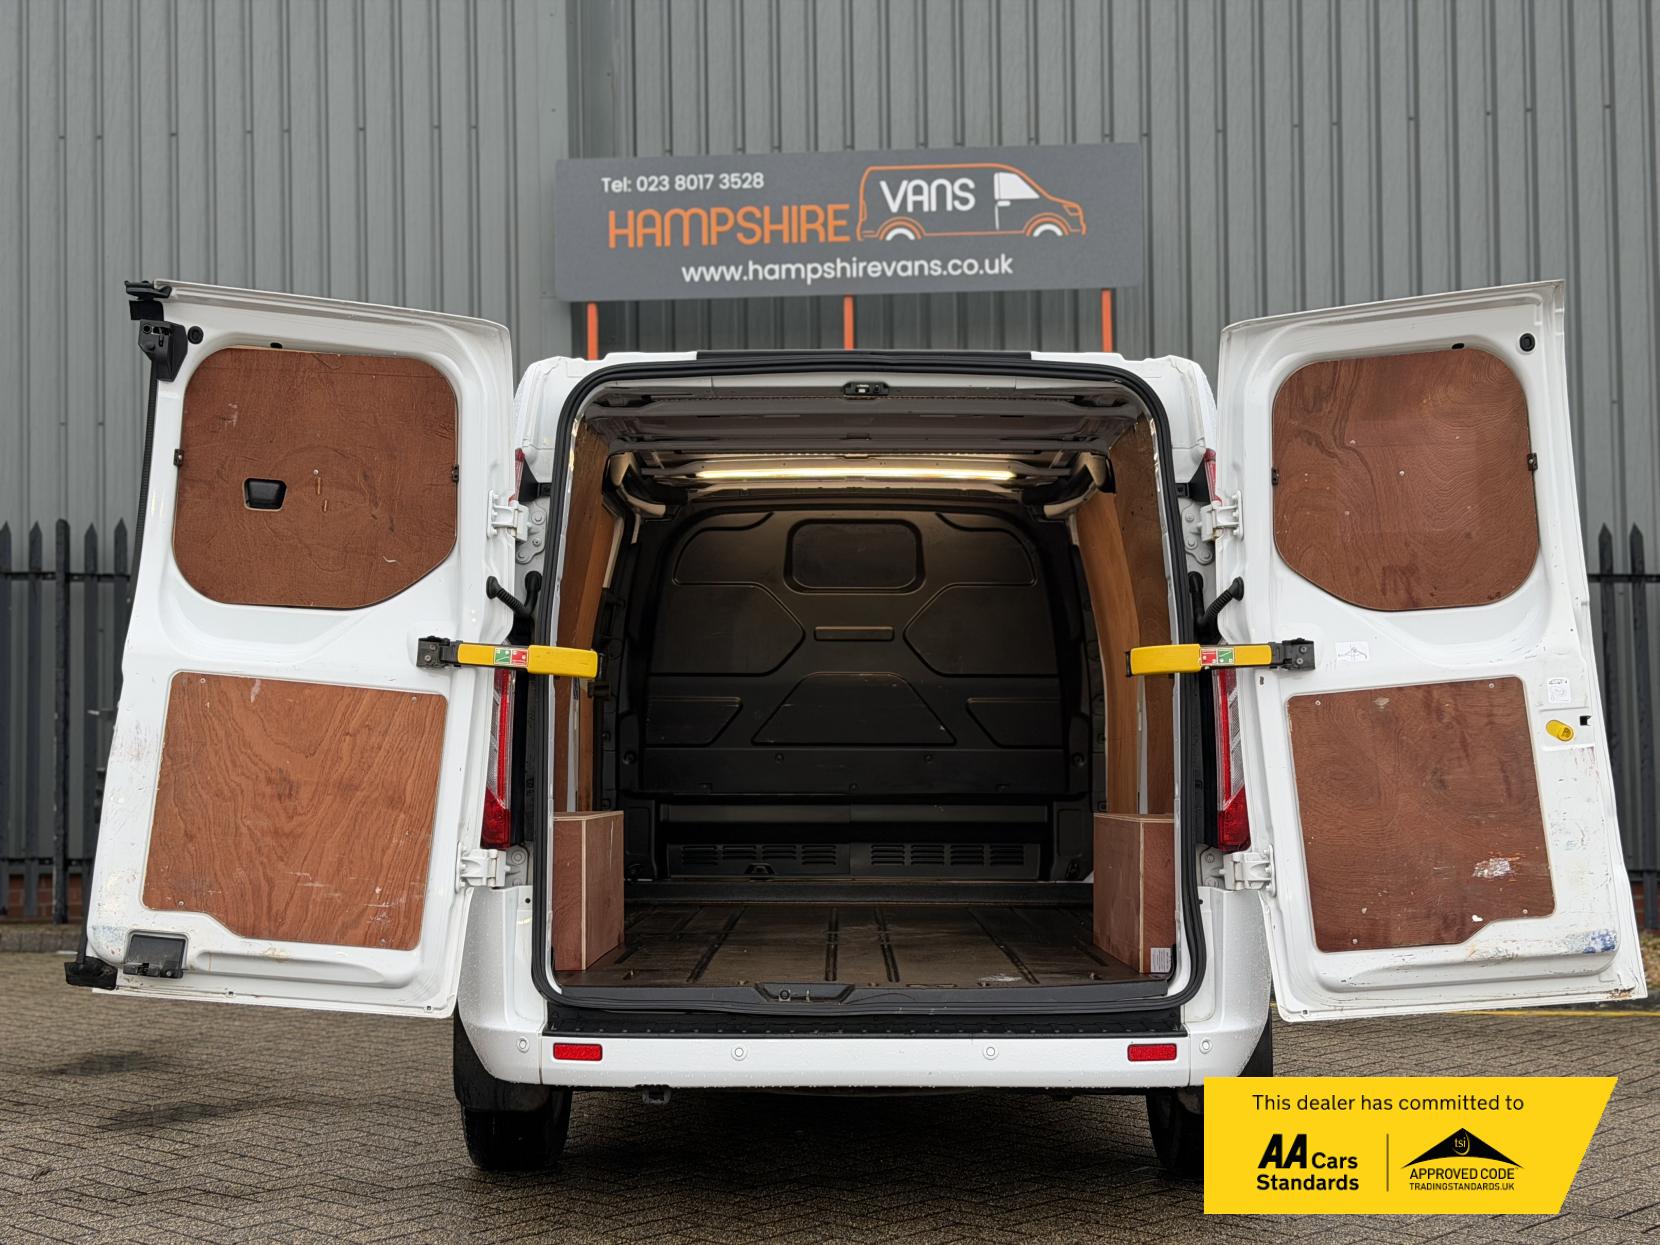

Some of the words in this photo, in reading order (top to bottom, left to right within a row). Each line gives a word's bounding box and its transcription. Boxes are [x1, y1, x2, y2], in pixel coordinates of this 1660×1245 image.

[601, 176, 632, 193] Tel:
[636, 175, 670, 193] 023
[674, 174, 714, 192] 8017
[719, 172, 765, 190] 3528
[879, 178, 976, 213] VANS
[608, 204, 850, 249] HAMPSHIRE
[682, 254, 1013, 285] www.hampshirevans.co.uk
